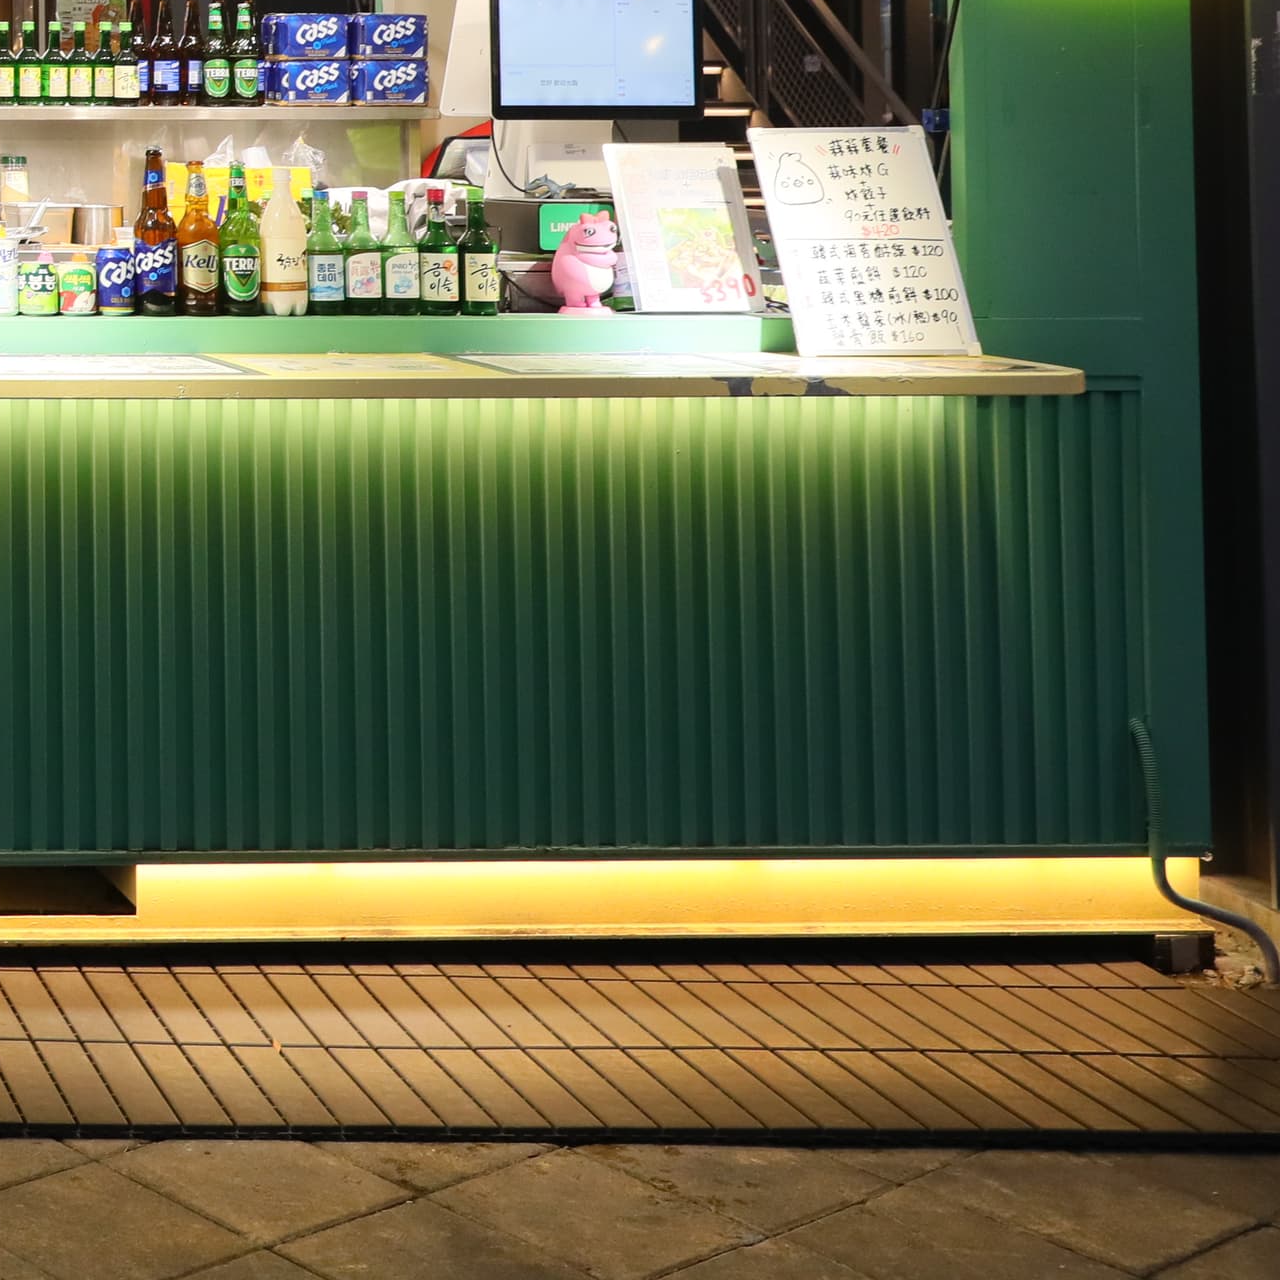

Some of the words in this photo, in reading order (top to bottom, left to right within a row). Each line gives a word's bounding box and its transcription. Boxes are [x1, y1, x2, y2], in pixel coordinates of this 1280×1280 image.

[295, 17, 338, 45] Cass
[372, 17, 416, 46] Cass
[295, 62, 340, 91] Cass
[373, 62, 417, 91] Cass
[861, 223, 900, 237] $420
[135, 246, 174, 274] Cass
[184, 254, 217, 274] Kelly
[911, 245, 944, 257] $120
[100, 257, 135, 288] Cas
[892, 265, 928, 279] $120
[923, 287, 959, 302] $100
